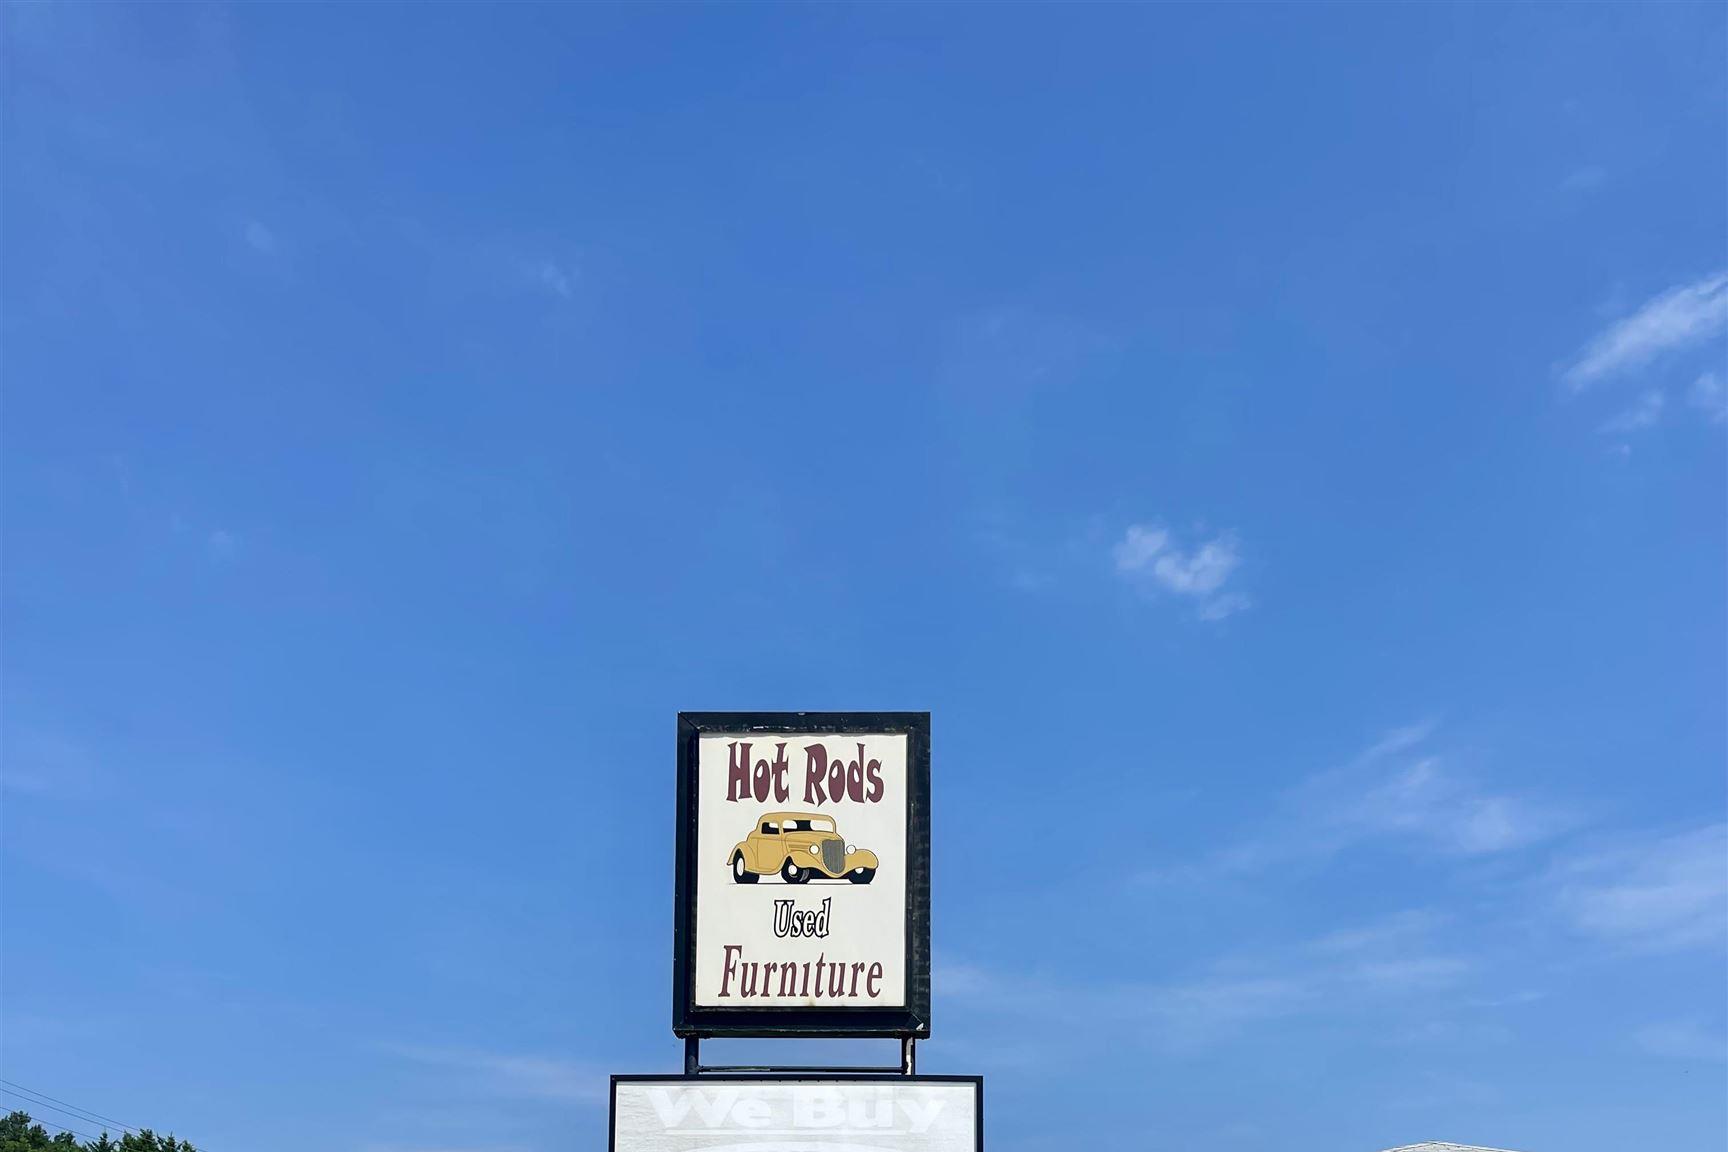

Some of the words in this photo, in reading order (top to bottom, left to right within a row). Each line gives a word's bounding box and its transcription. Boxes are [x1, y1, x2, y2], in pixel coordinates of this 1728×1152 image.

[725, 741, 790, 804] Hot
[803, 742, 885, 808] Rods
[773, 896, 832, 939] Used
[717, 944, 884, 998] Furniture
[649, 1087, 772, 1128] We
[792, 1087, 946, 1134] Buy
